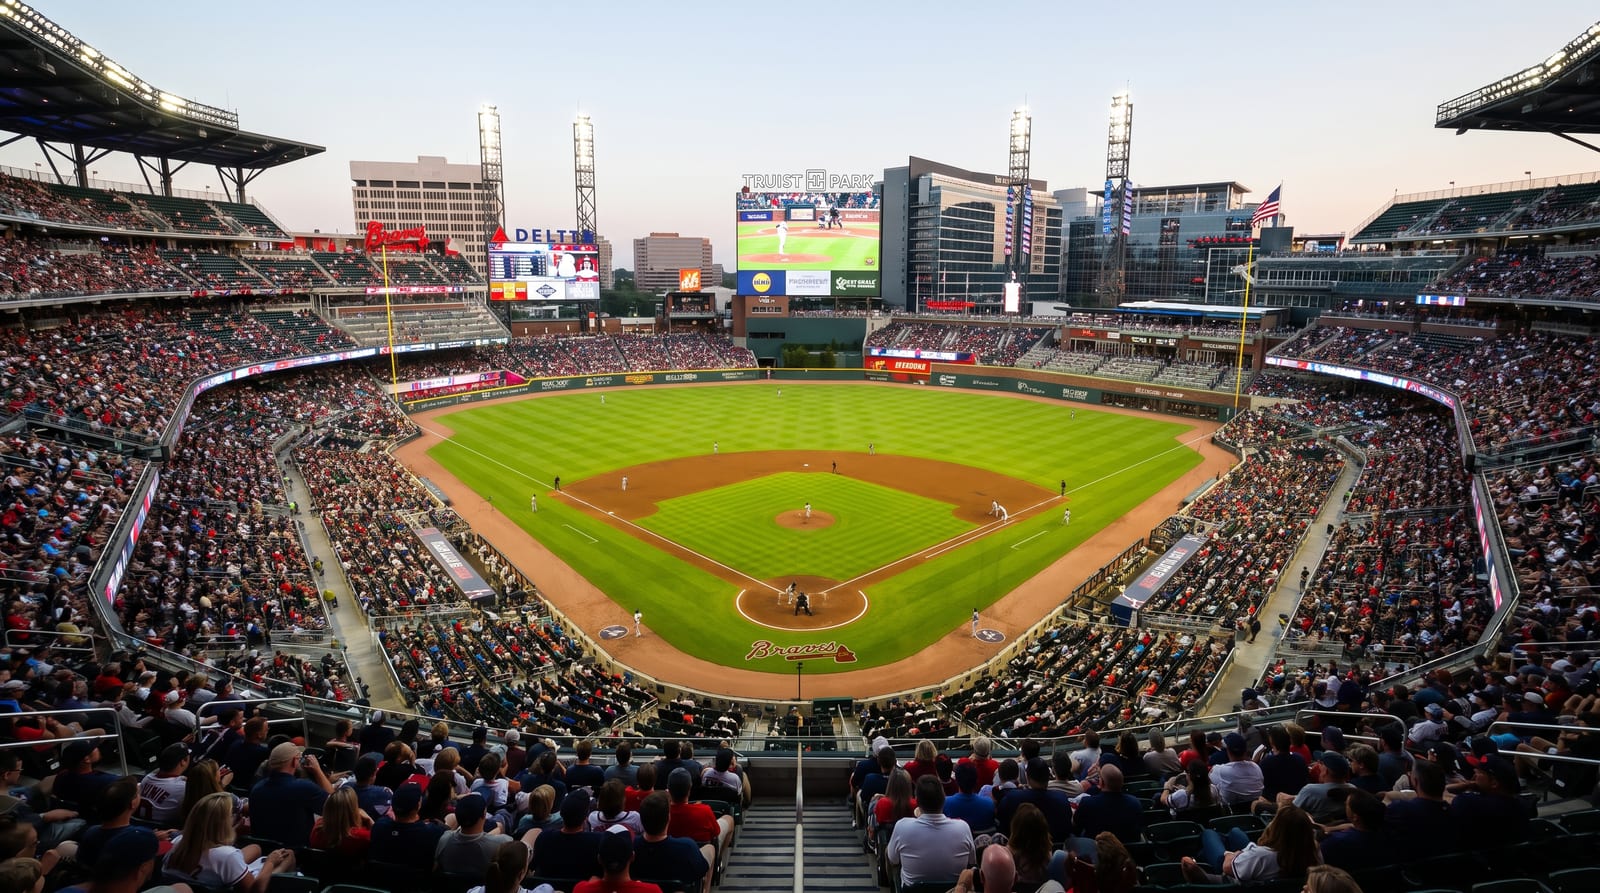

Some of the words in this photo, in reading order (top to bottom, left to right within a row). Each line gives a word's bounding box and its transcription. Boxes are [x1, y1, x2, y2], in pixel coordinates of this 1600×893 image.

[742, 174, 803, 189] TRUIST
[829, 174, 874, 189] PARK
[745, 640, 837, 661] Braves
